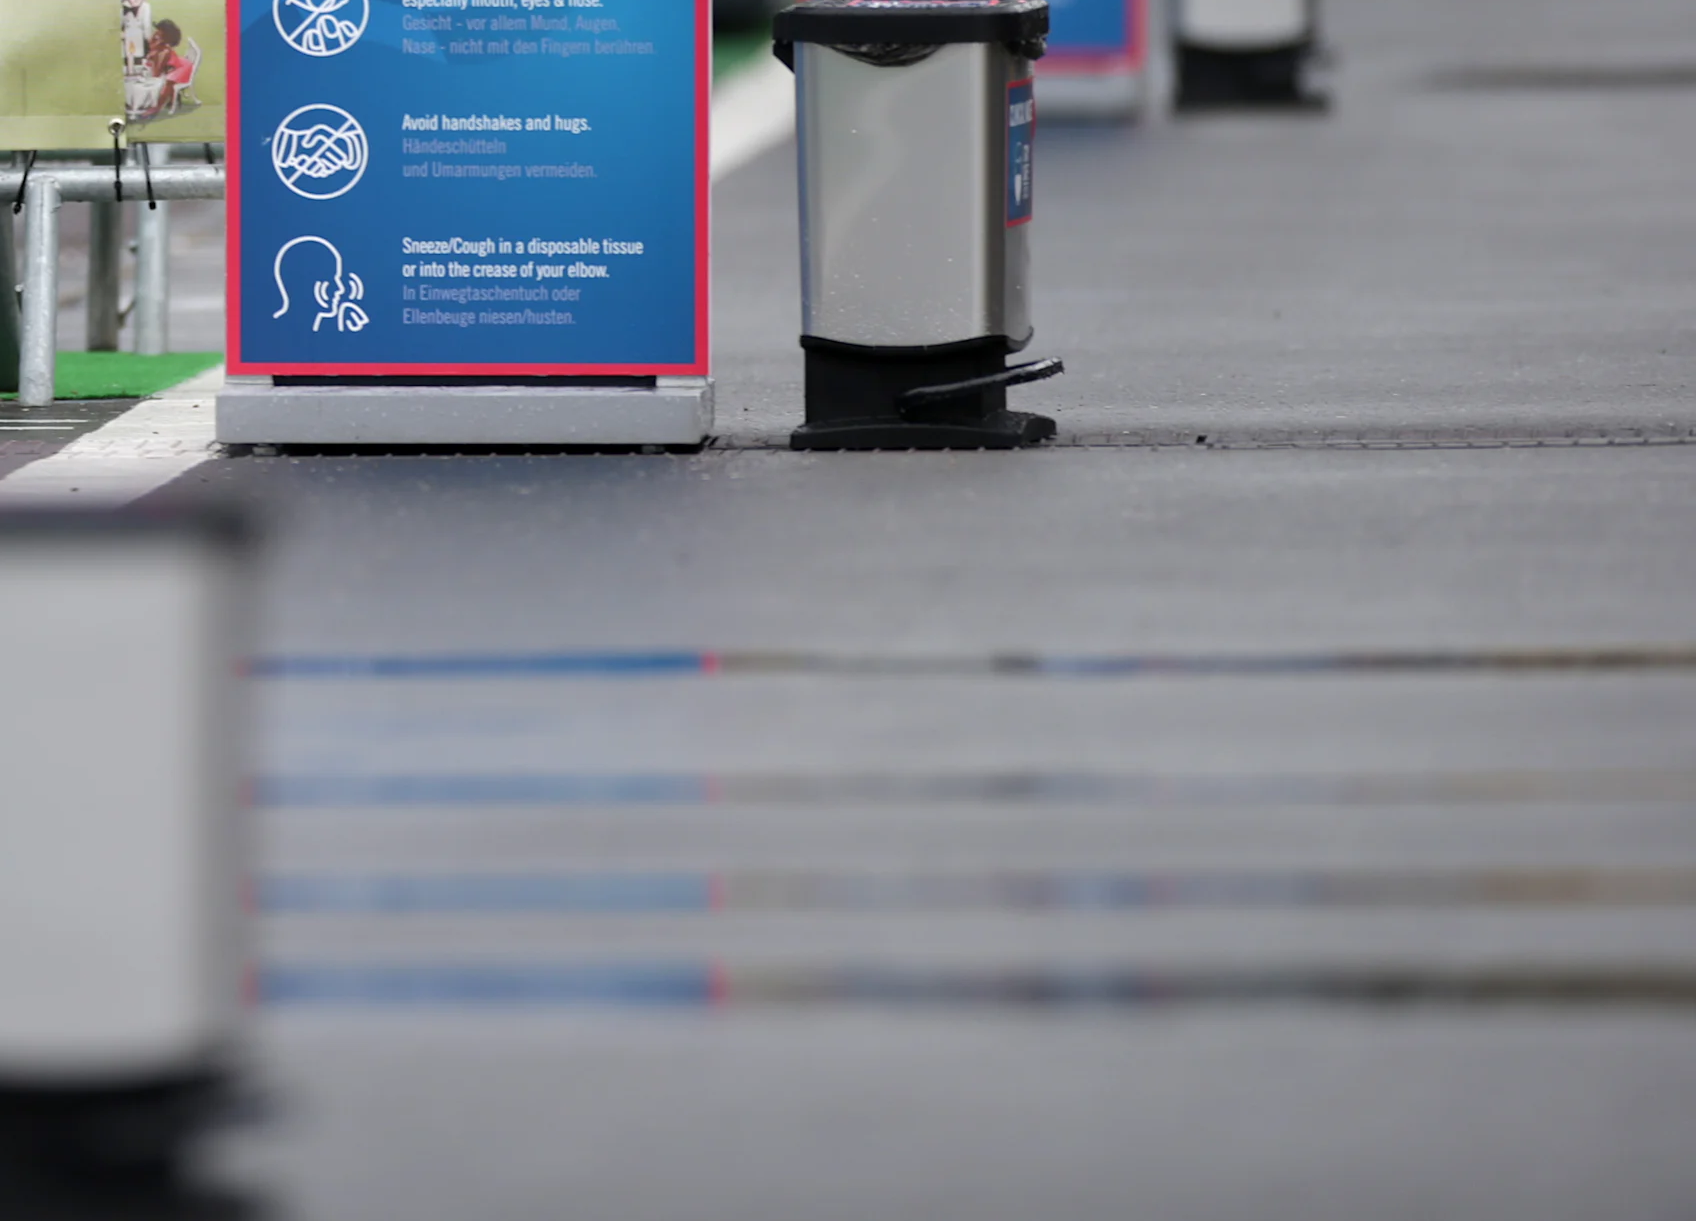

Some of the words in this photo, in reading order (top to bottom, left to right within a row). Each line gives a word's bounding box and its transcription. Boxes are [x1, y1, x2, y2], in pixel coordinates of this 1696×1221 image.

[402, 13, 453, 31] Gesicht
[465, 17, 487, 31] vor
[489, 14, 527, 31] allem
[401, 37, 437, 55] Nase
[449, 38, 484, 55] nicht
[486, 38, 510, 55] mit
[512, 38, 538, 55] den
[540, 36, 591, 58] Fingern
[401, 113, 439, 131] Avoid
[441, 114, 523, 132] handshakes
[524, 114, 552, 132] and
[554, 114, 592, 135] hugs.
[401, 137, 508, 155] Händeschütteln
[402, 161, 429, 178] und
[431, 161, 522, 181] Umarmungen
[524, 161, 598, 179] vermeiden.
[402, 236, 496, 258] Sneeze/Cough
[498, 237, 513, 254] in
[515, 240, 525, 255] a
[527, 237, 601, 258] disposable
[602, 238, 644, 255] tissue
[401, 263, 418, 278] or
[419, 260, 446, 278] into
[447, 260, 471, 278] the
[472, 264, 518, 278] crease
[519, 260, 534, 278] of
[535, 264, 566, 281] your
[567, 261, 610, 279] elbow.
[402, 284, 416, 301] In
[419, 284, 549, 305] Einwegtaschentuch
[551, 285, 582, 302] oder
[402, 307, 477, 328] Ellenbeuge
[478, 308, 576, 325] niesen/husten.
